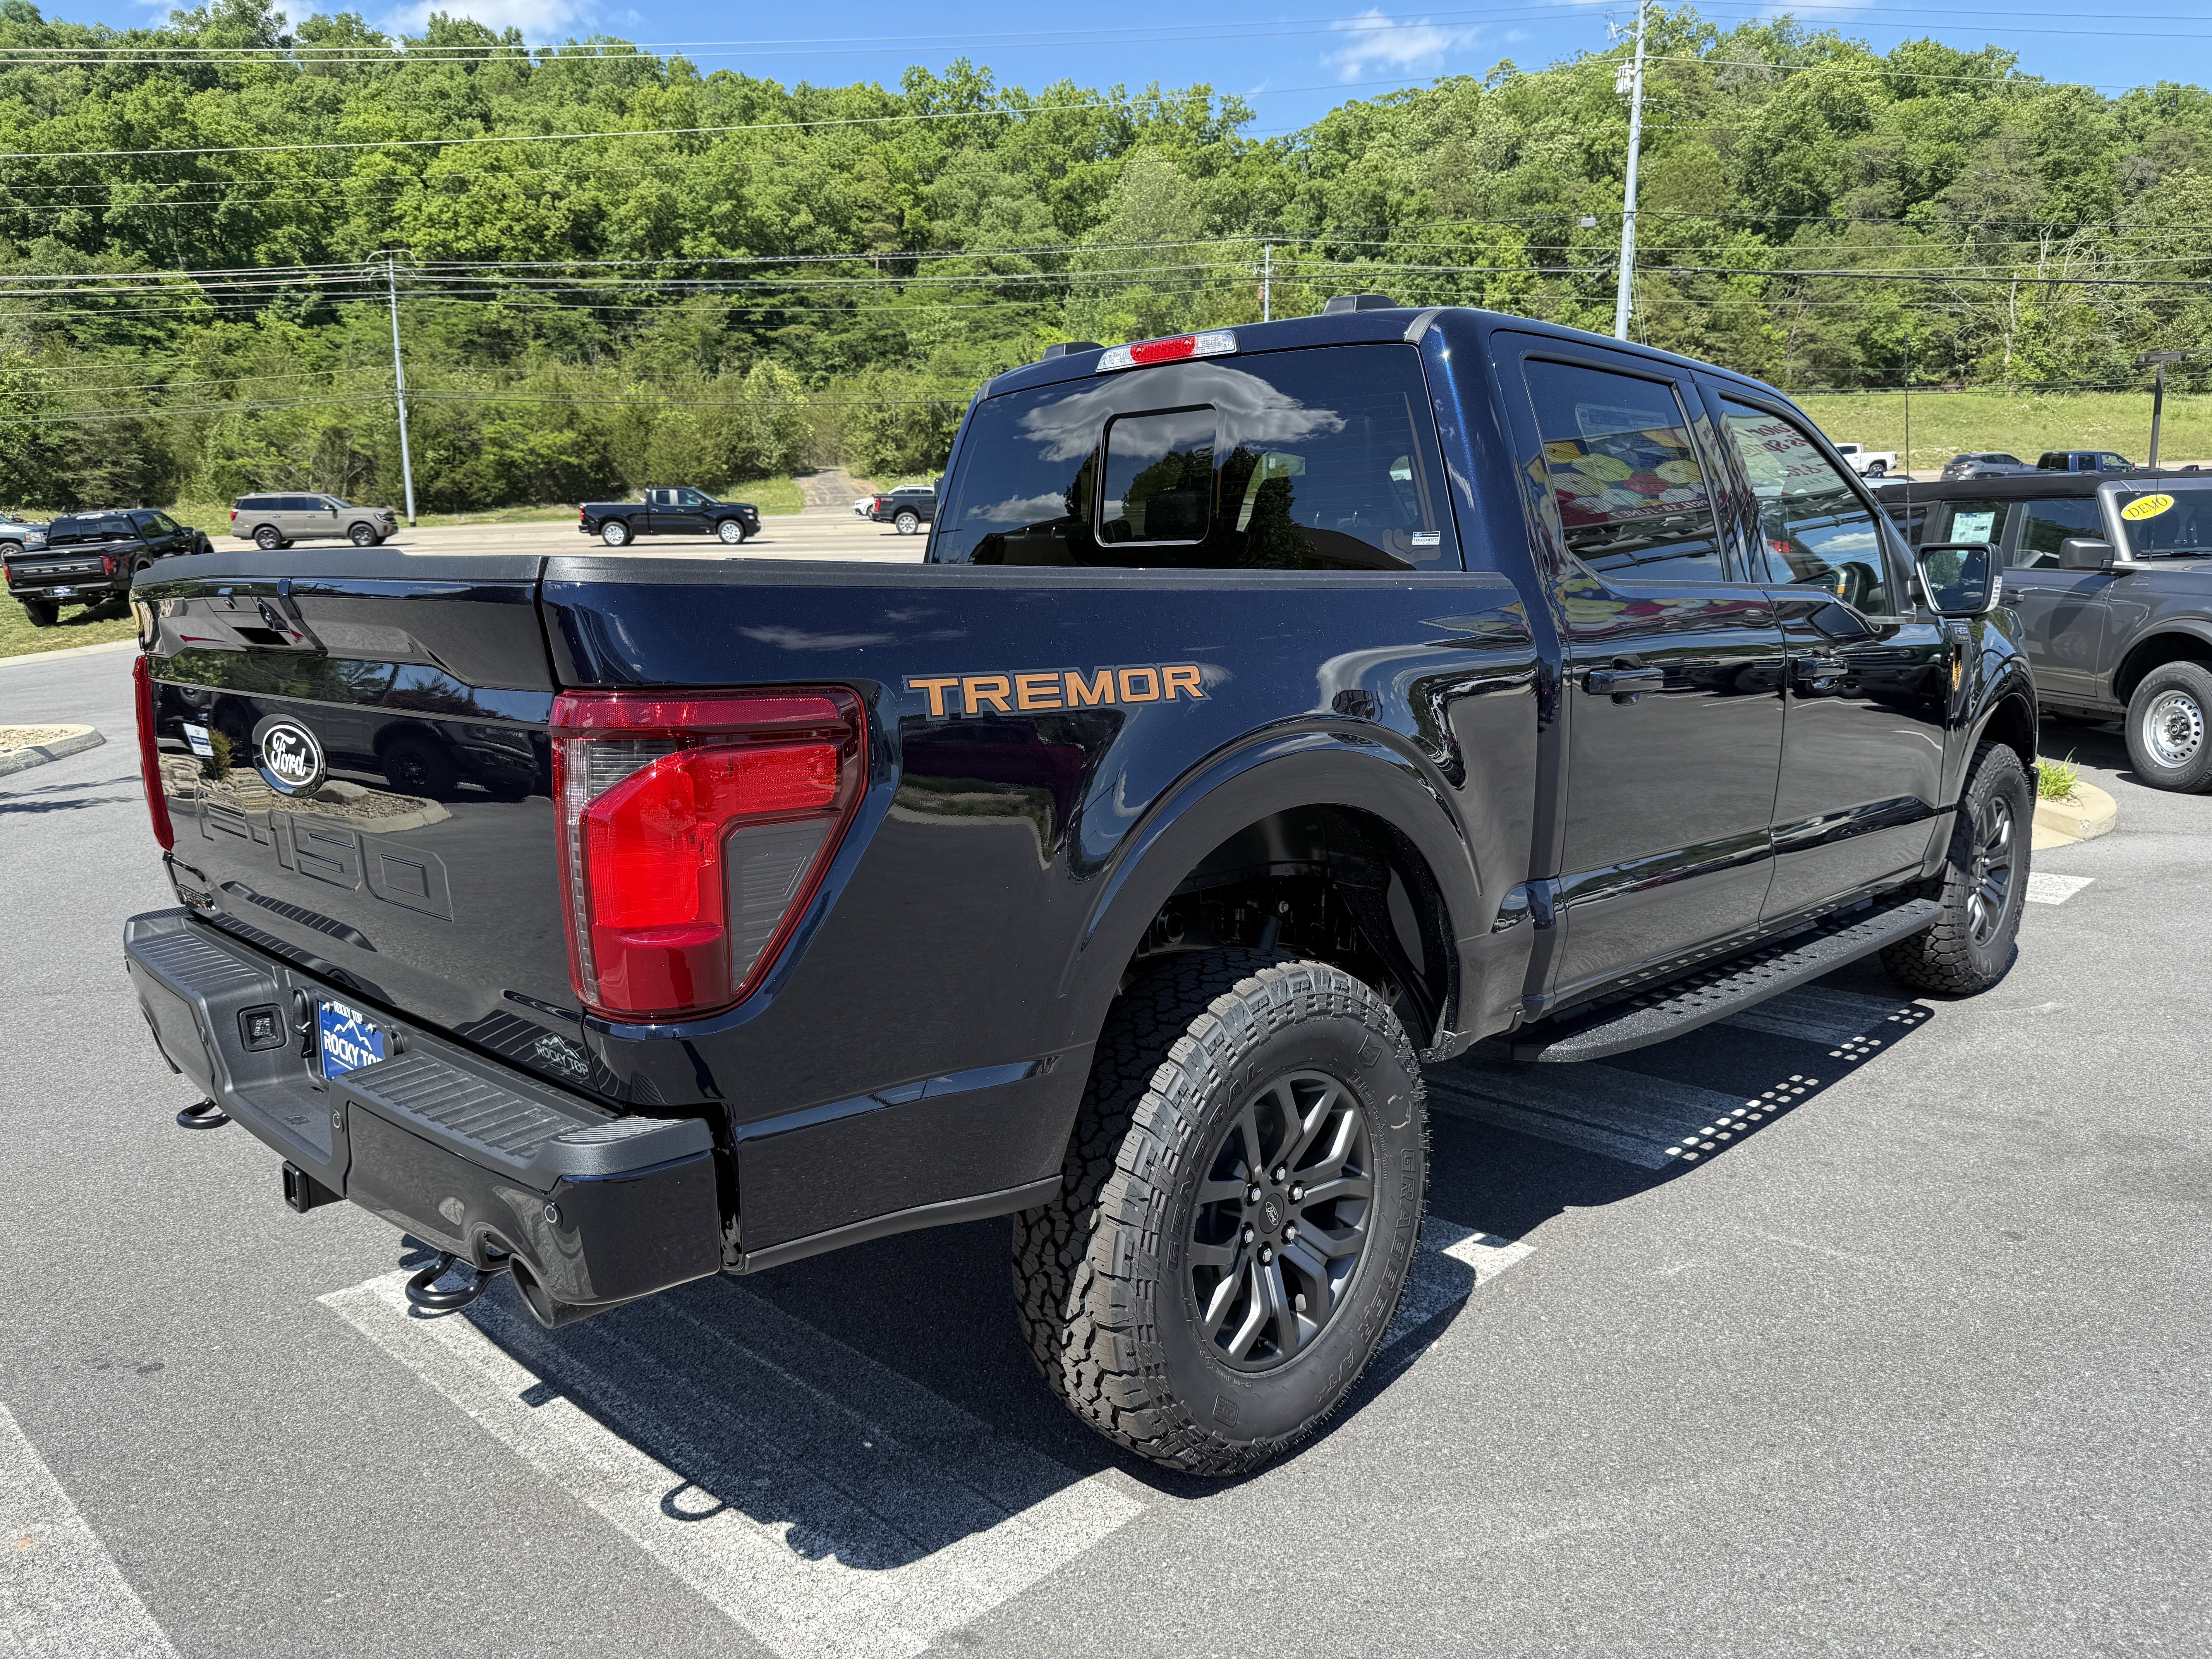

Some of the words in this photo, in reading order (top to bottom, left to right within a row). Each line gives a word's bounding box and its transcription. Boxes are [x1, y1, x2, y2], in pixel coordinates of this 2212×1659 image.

[2127, 497, 2168, 517] DEMO
[908, 665, 1205, 716] TREMOR
[270, 731, 307, 777] Ford
[333, 1001, 351, 1019] ROCKY
[351, 1010, 363, 1025] TOP
[323, 1029, 359, 1066] ROCKY
[534, 1042, 567, 1067] ROCKY
[567, 1056, 589, 1075] TOP
[1166, 1062, 1264, 1271] GENERAL
[1267, 1206, 1277, 1223] Ford
[1357, 1148, 1415, 1345] GRABBER
